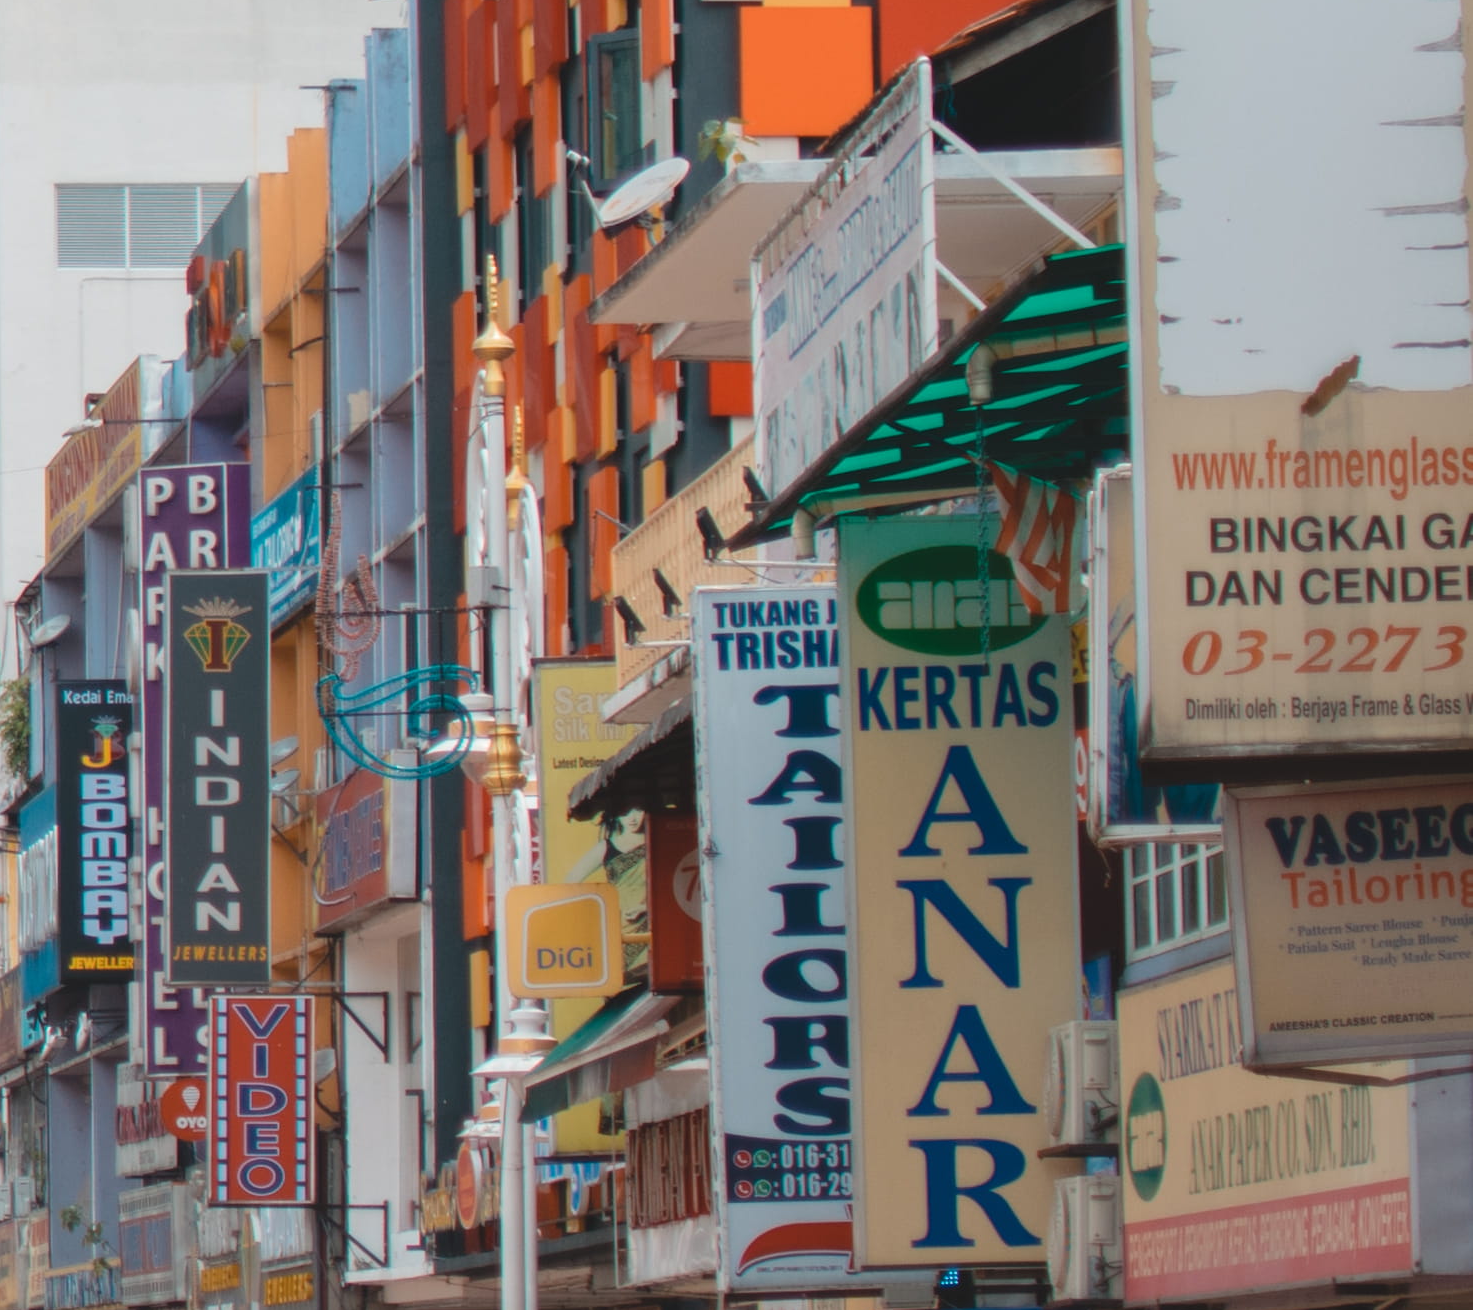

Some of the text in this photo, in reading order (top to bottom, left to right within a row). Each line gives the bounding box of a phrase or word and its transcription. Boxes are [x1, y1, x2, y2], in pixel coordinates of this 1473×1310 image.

[1172, 436, 1473, 501] www.framenglass
[1210, 514, 1406, 553] BINGKAI
[1185, 569, 1283, 606] DAN
[712, 599, 819, 629] TUKANG
[1182, 625, 1468, 676] 03-2273
[63, 690, 102, 705] Kedai
[857, 660, 1061, 731] KERTAS
[1185, 697, 1241, 720] Dimiliki
[1245, 697, 1277, 719] oleh
[1291, 696, 1347, 724] Berjaya
[1351, 695, 1398, 717] Frame
[1403, 694, 1414, 716] &
[1419, 692, 1461, 715] Glass
[553, 757, 577, 770] Latest
[194, 689, 241, 932] INDIAN
[81, 773, 128, 945] BOMBAY
[1281, 862, 1473, 909] Tailoring
[747, 684, 852, 1136] TAILORS
[1287, 941, 1329, 955] Patiala
[1331, 938, 1356, 952] Suit
[1417, 931, 1459, 947] Blouse
[1298, 918, 1423, 938] Pattern Saree Blouse
[173, 945, 268, 962] JEWELLERS
[536, 946, 594, 970] DiGi
[1362, 952, 1398, 968] Ready
[1402, 949, 1435, 965] Made
[897, 744, 1043, 1248] ANAR
[1157, 993, 1225, 1083] SYARIKAT
[1269, 1012, 1435, 1033] AMEESHA'S CLASSIC CREATION
[232, 1003, 290, 1196] VIDEO
[176, 1116, 208, 1129] OYO
[781, 1143, 852, 1169] 016-31
[1188, 1115, 1226, 1196] ANAR
[1228, 1104, 1273, 1188] PAPER
[1277, 1098, 1301, 1179] CO.
[1304, 1091, 1336, 1175] SDN.
[781, 1172, 853, 1198] 016-29
